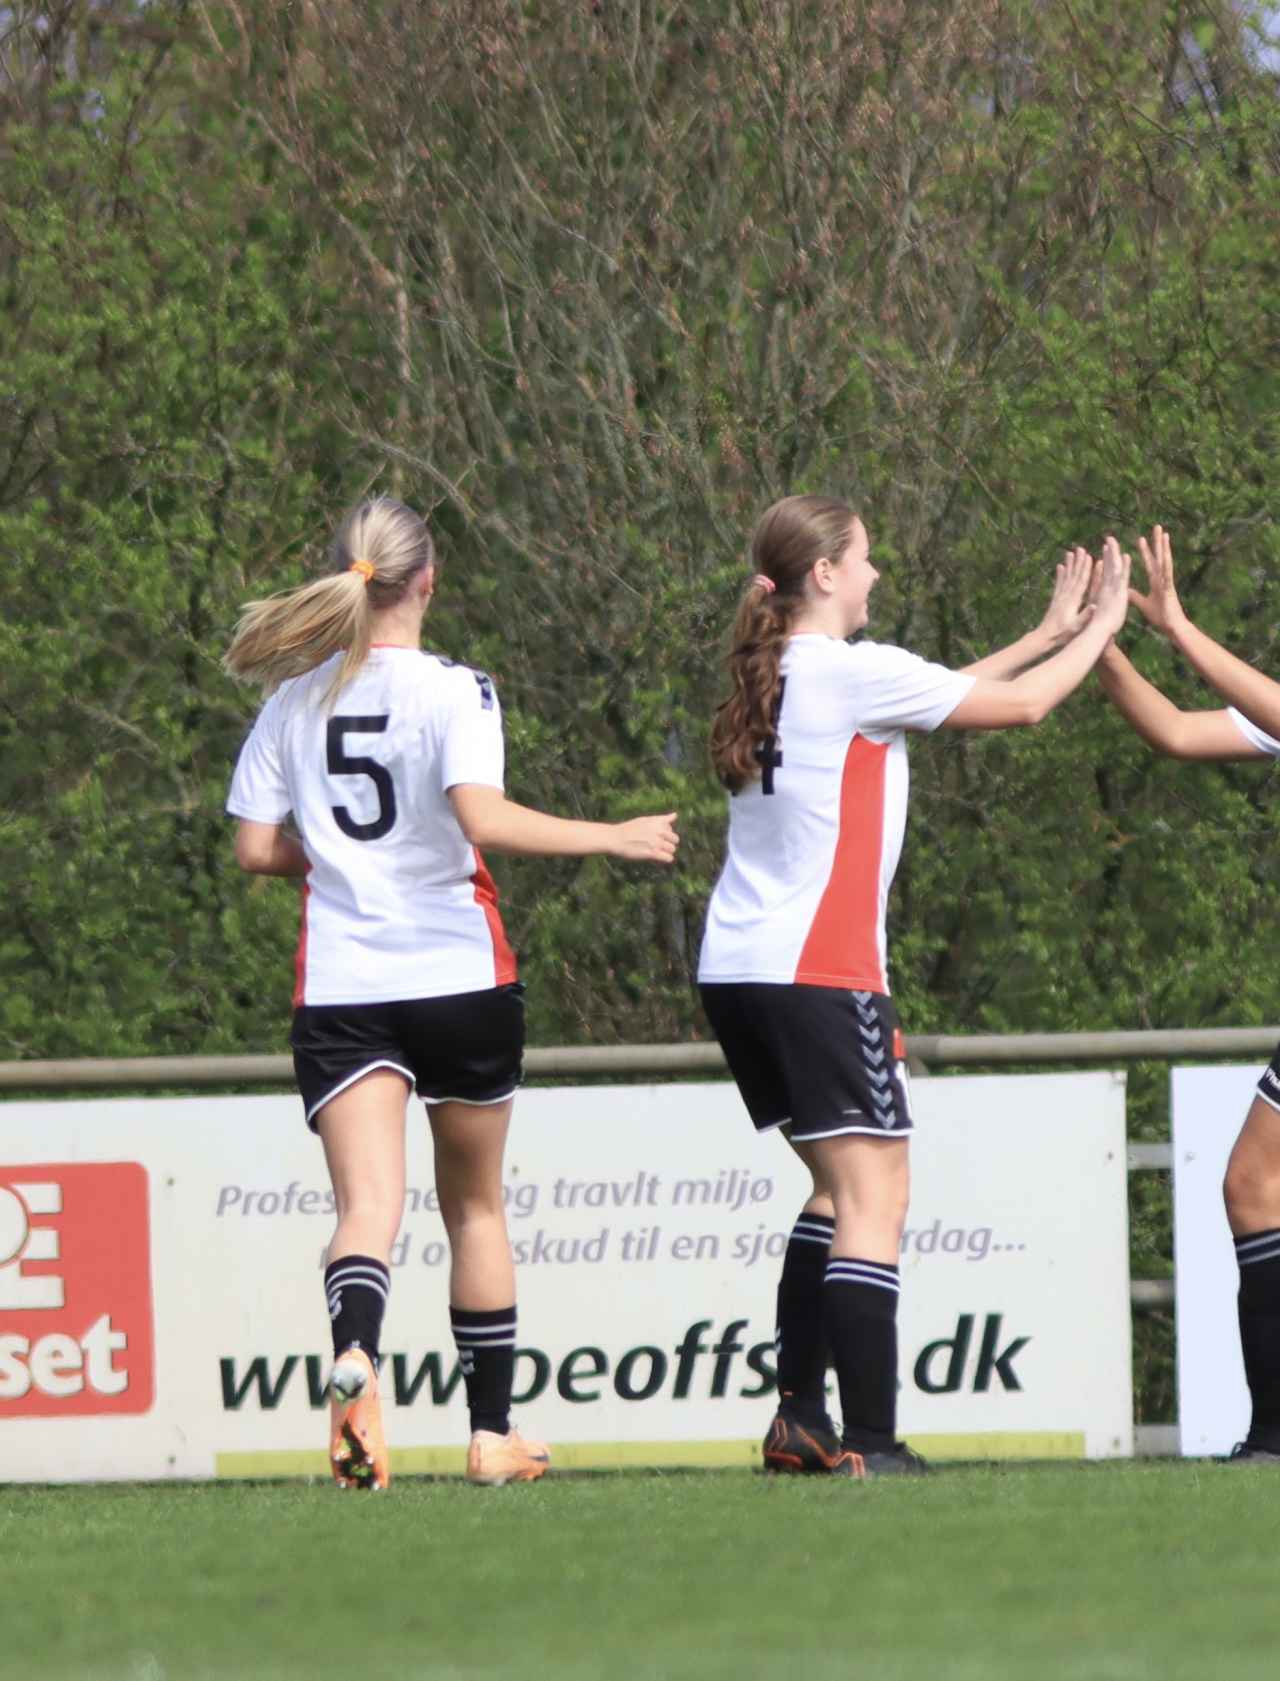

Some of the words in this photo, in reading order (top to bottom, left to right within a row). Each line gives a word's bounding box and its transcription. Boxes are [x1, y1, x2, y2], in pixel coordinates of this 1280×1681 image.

[326, 715, 397, 841] 5
[552, 1171, 662, 1208] travlt
[672, 1168, 773, 1212] miljø
[620, 1226, 661, 1261] til
[670, 1233, 720, 1261] en
[731, 1224, 787, 1267] sjo
